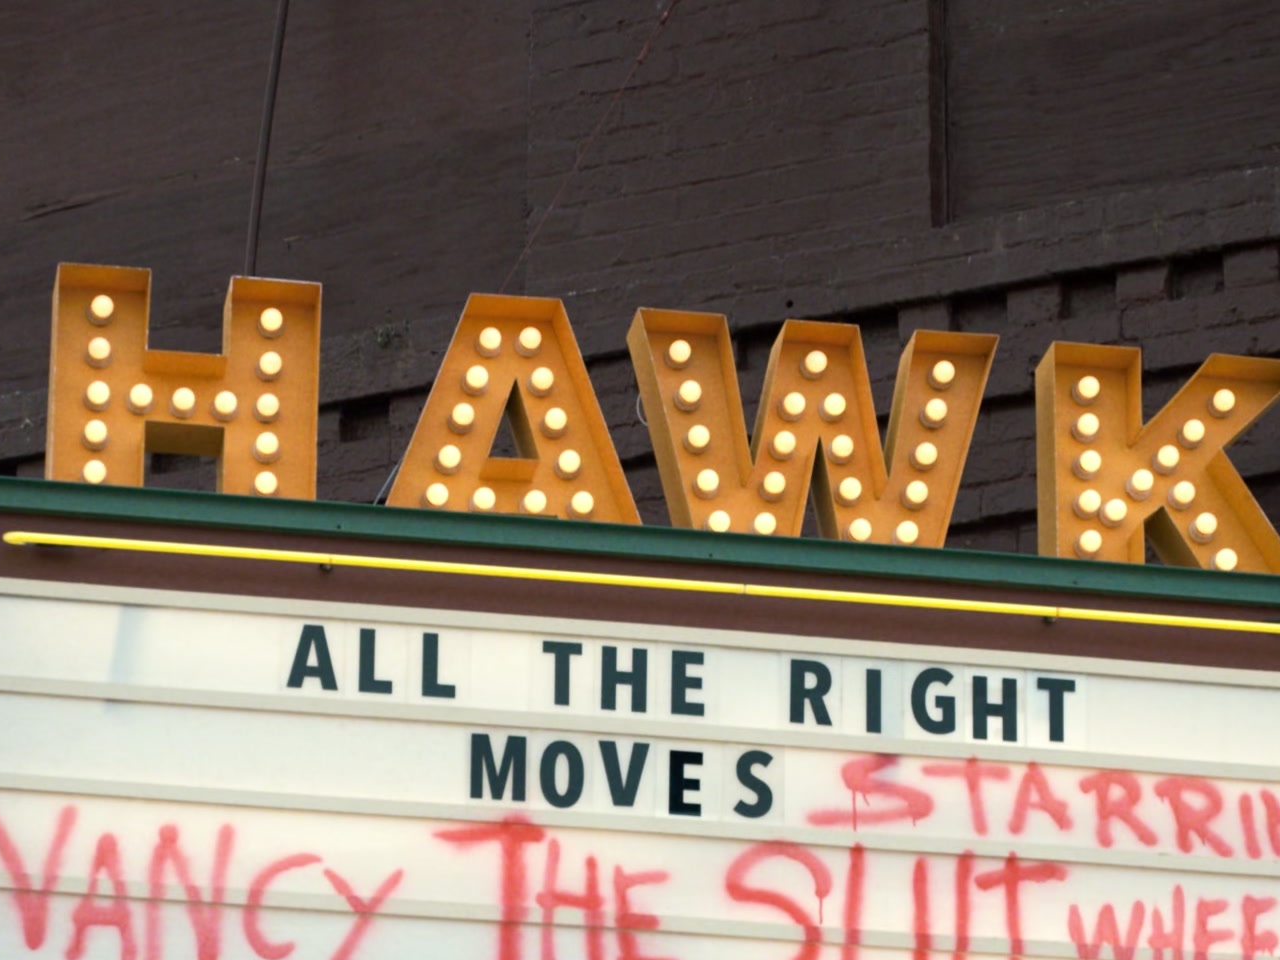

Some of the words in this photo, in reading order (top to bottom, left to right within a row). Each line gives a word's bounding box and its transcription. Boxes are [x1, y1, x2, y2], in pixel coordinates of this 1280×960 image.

[286, 624, 457, 699] ALL
[542, 640, 705, 717] THE
[789, 659, 1077, 743] RIGHT
[469, 733, 775, 818] MOVES
